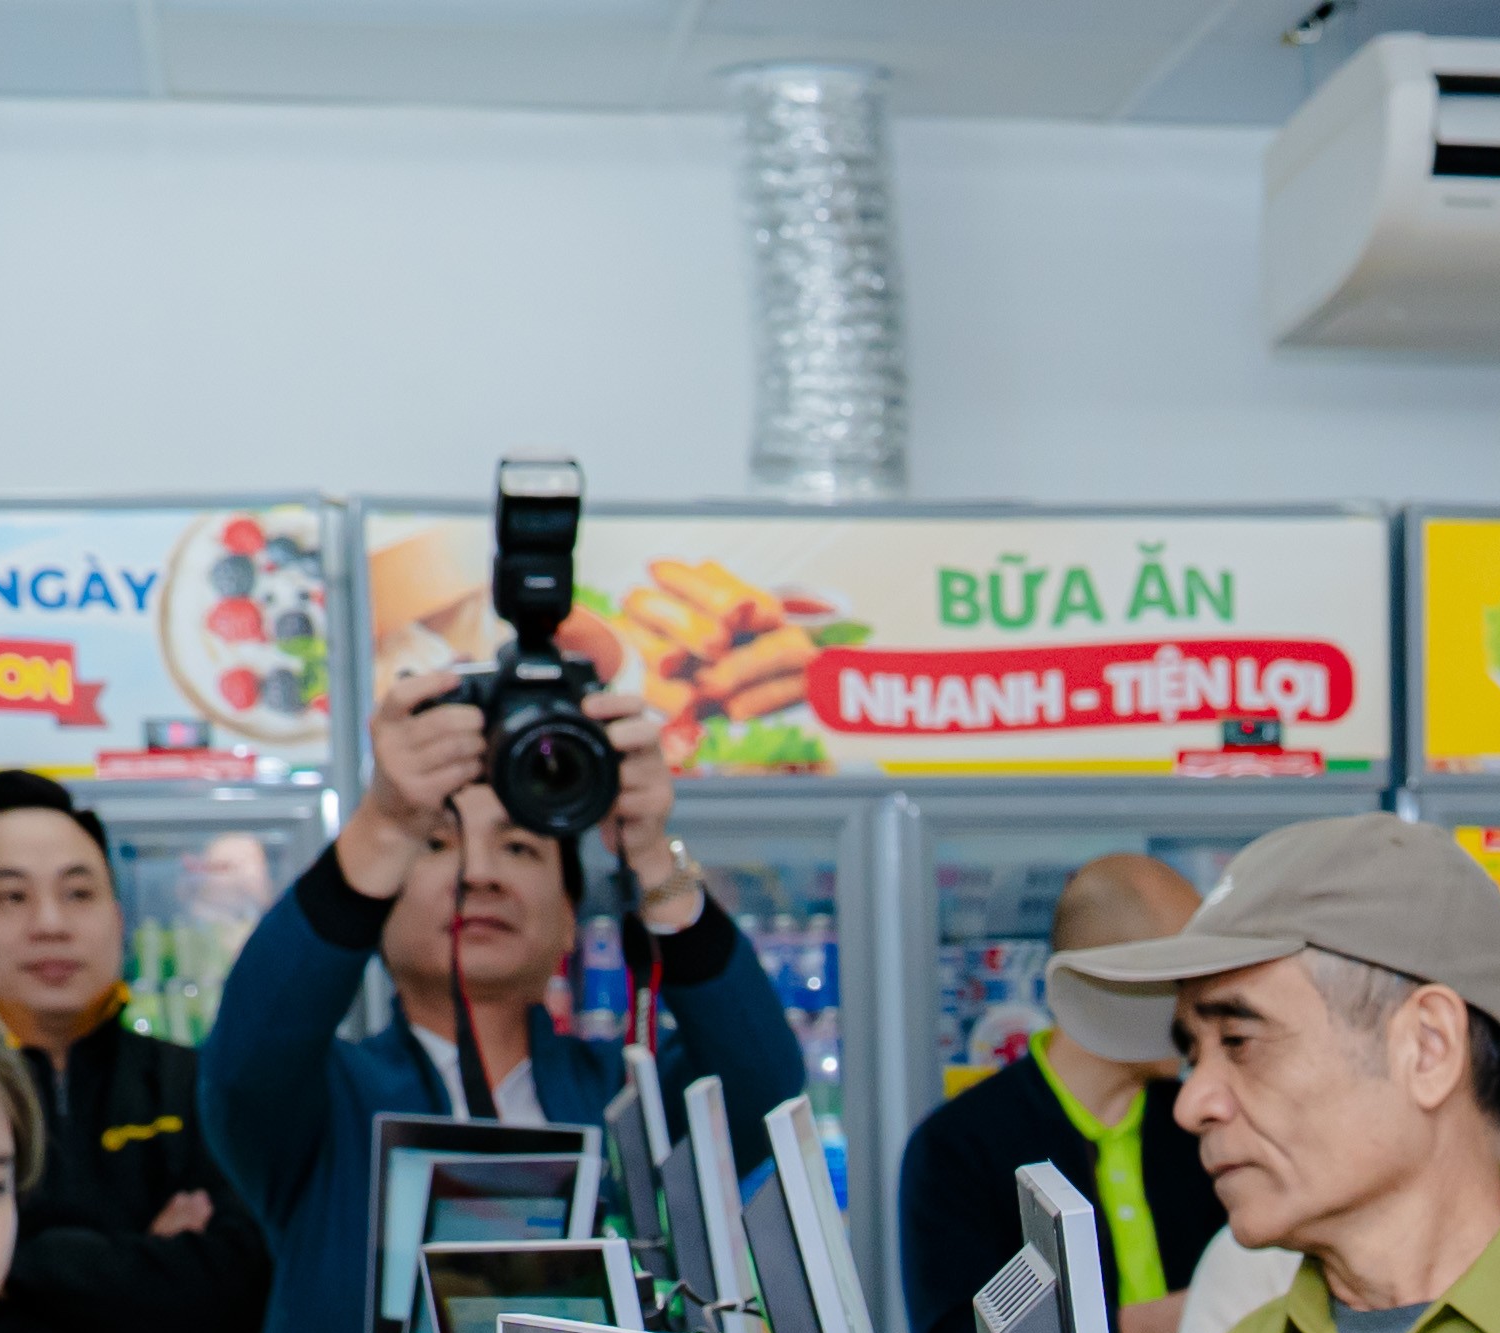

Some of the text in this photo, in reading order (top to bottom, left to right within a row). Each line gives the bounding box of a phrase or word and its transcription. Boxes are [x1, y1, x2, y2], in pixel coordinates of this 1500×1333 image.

[937, 541, 1235, 631] BỮA ĂN
[838, 668, 1065, 729] NHANH
[1103, 643, 1230, 722] TIỆN
[1236, 657, 1331, 722] LỢI
